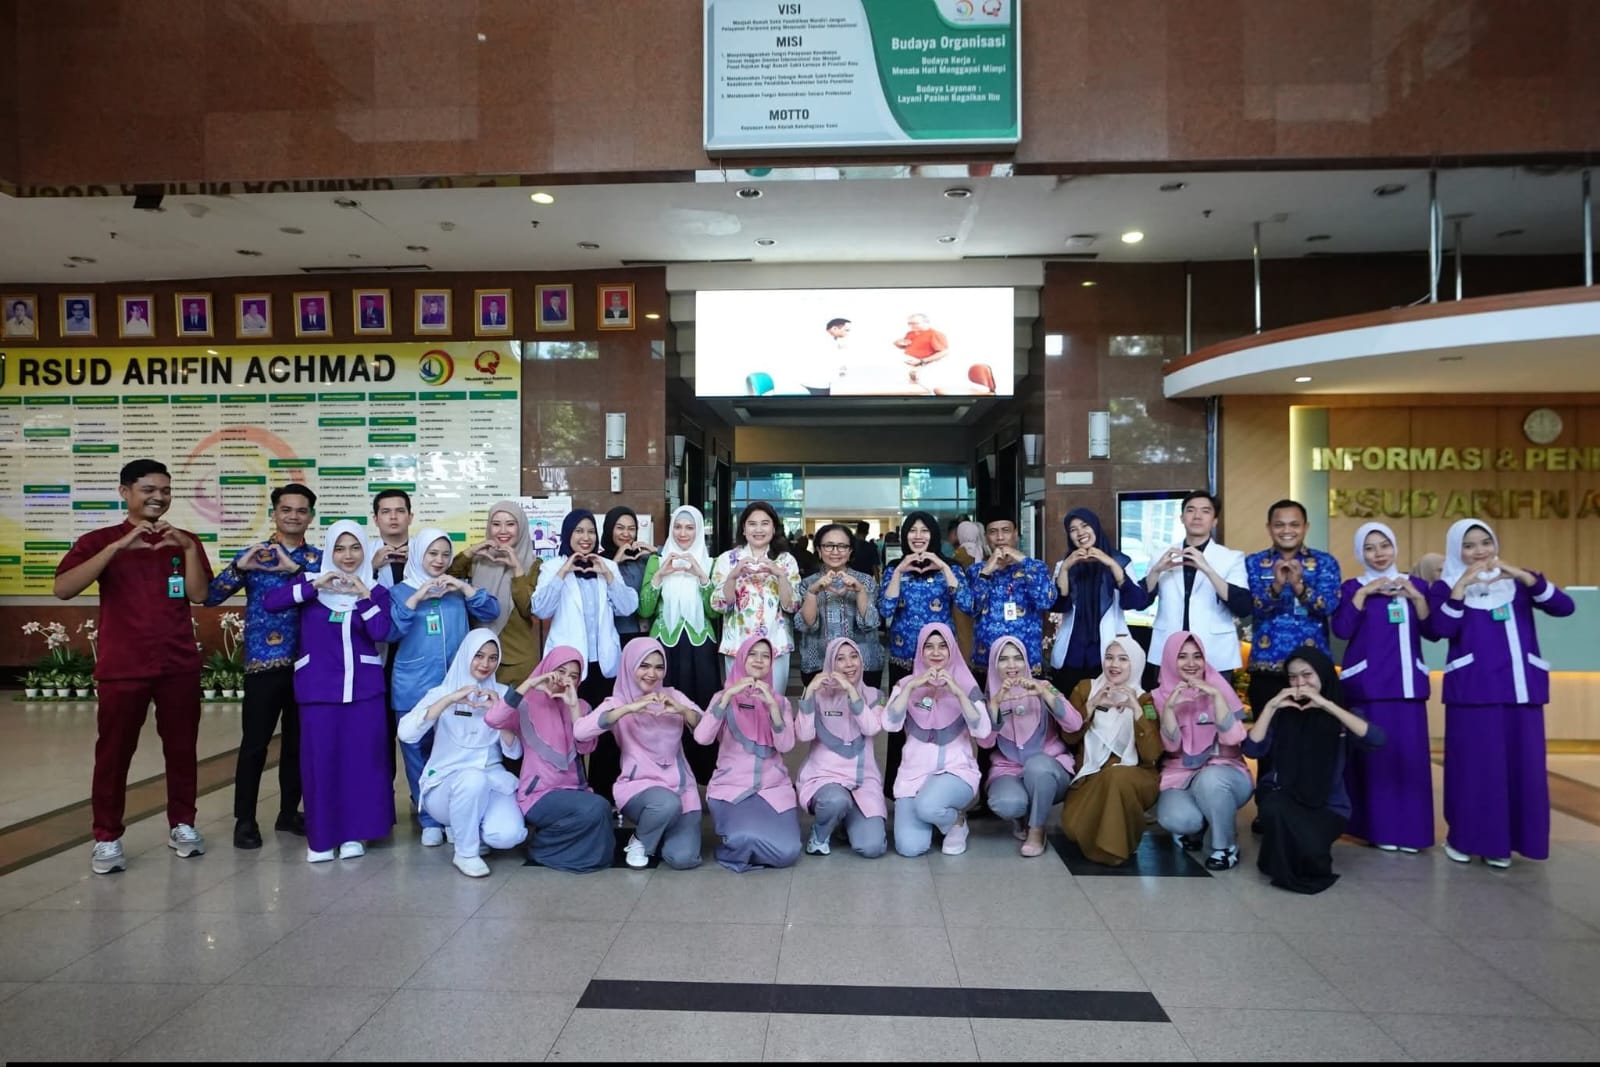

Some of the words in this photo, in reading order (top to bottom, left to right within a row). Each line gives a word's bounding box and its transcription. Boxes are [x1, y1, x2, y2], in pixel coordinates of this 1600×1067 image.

[778, 4, 801, 15] VISI
[777, 36, 802, 48] MISI
[891, 37, 936, 51] Budaya
[941, 34, 1006, 51] Organisasi
[922, 56, 949, 65] Budaya
[951, 55, 970, 65] Kerja
[892, 67, 919, 75] Menata
[922, 66, 937, 74] Hati
[939, 65, 980, 75] Menggapai
[982, 64, 1006, 74] Mimpi
[916, 84, 943, 94] Budaya
[945, 84, 976, 93] Layanan
[898, 95, 922, 104] Layani
[924, 94, 949, 102] Pasien
[951, 94, 986, 103] Bagaikan
[769, 109, 809, 121] MOTTO
[19, 358, 112, 386] RSUD
[122, 357, 232, 385] ARIFIN
[244, 354, 396, 383] ACHMAD
[1312, 447, 1490, 471] INFORMASI
[1495, 448, 1518, 470] &
[1328, 488, 1439, 518] RSUD
[1444, 488, 1569, 518] ARIFIN
